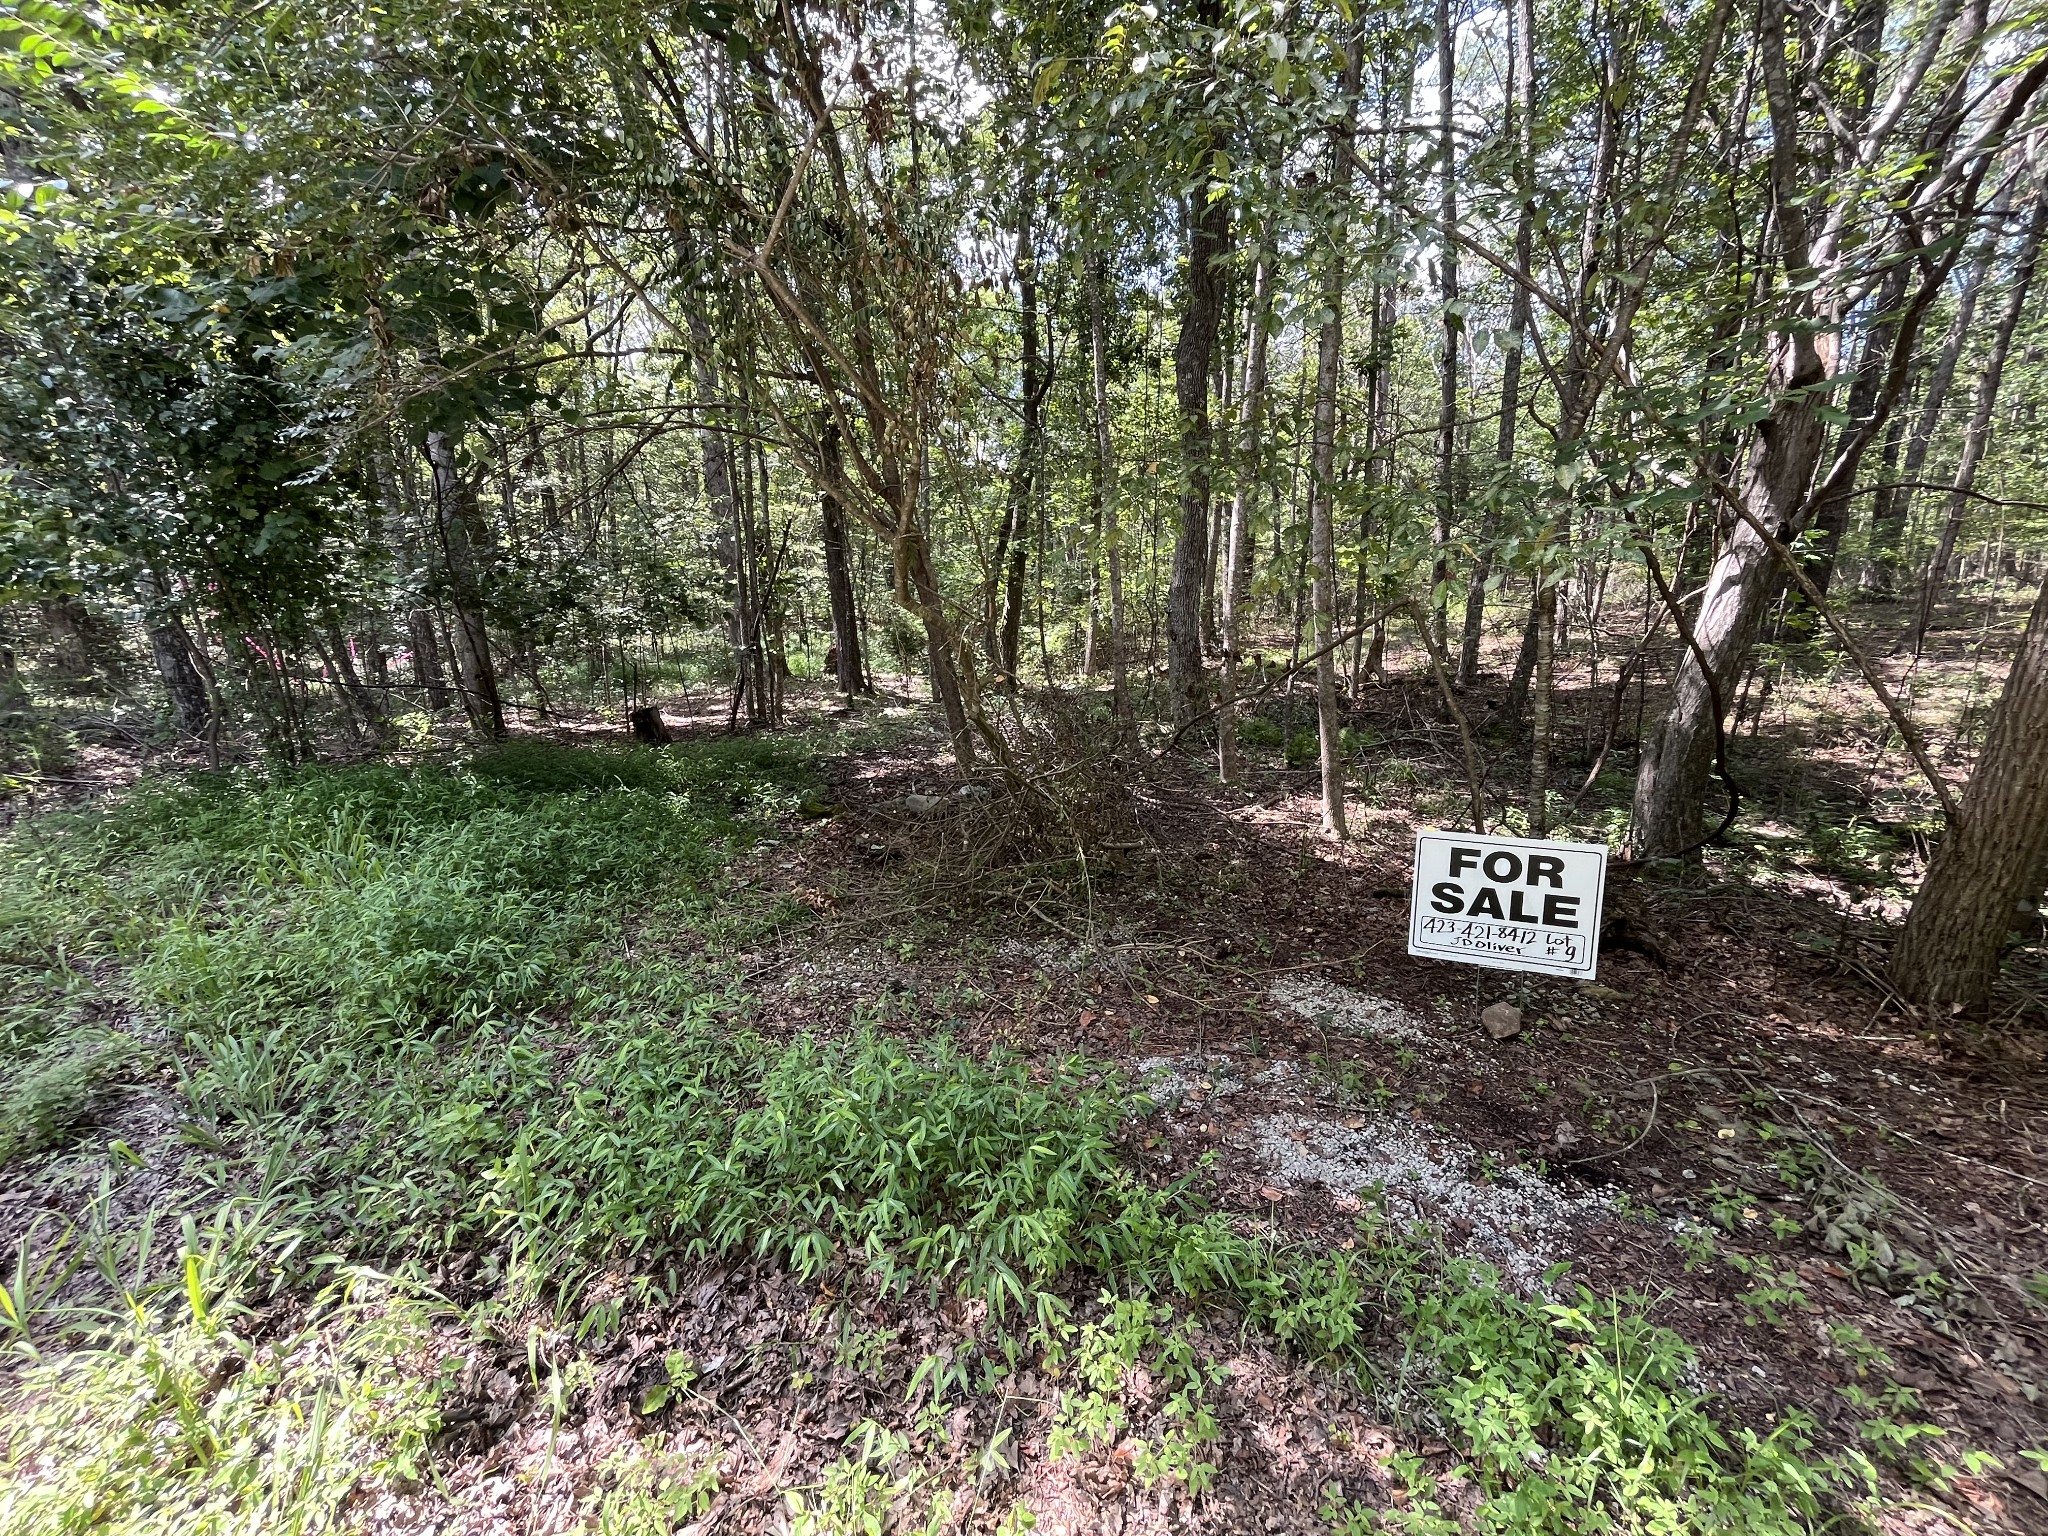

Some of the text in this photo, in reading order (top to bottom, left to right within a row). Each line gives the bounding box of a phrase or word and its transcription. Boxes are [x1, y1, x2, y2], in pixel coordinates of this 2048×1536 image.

[1449, 847, 1565, 889] FOR
[1430, 882, 1581, 928] SALE
[1423, 918, 1573, 947] 423-421-8412 Lot
